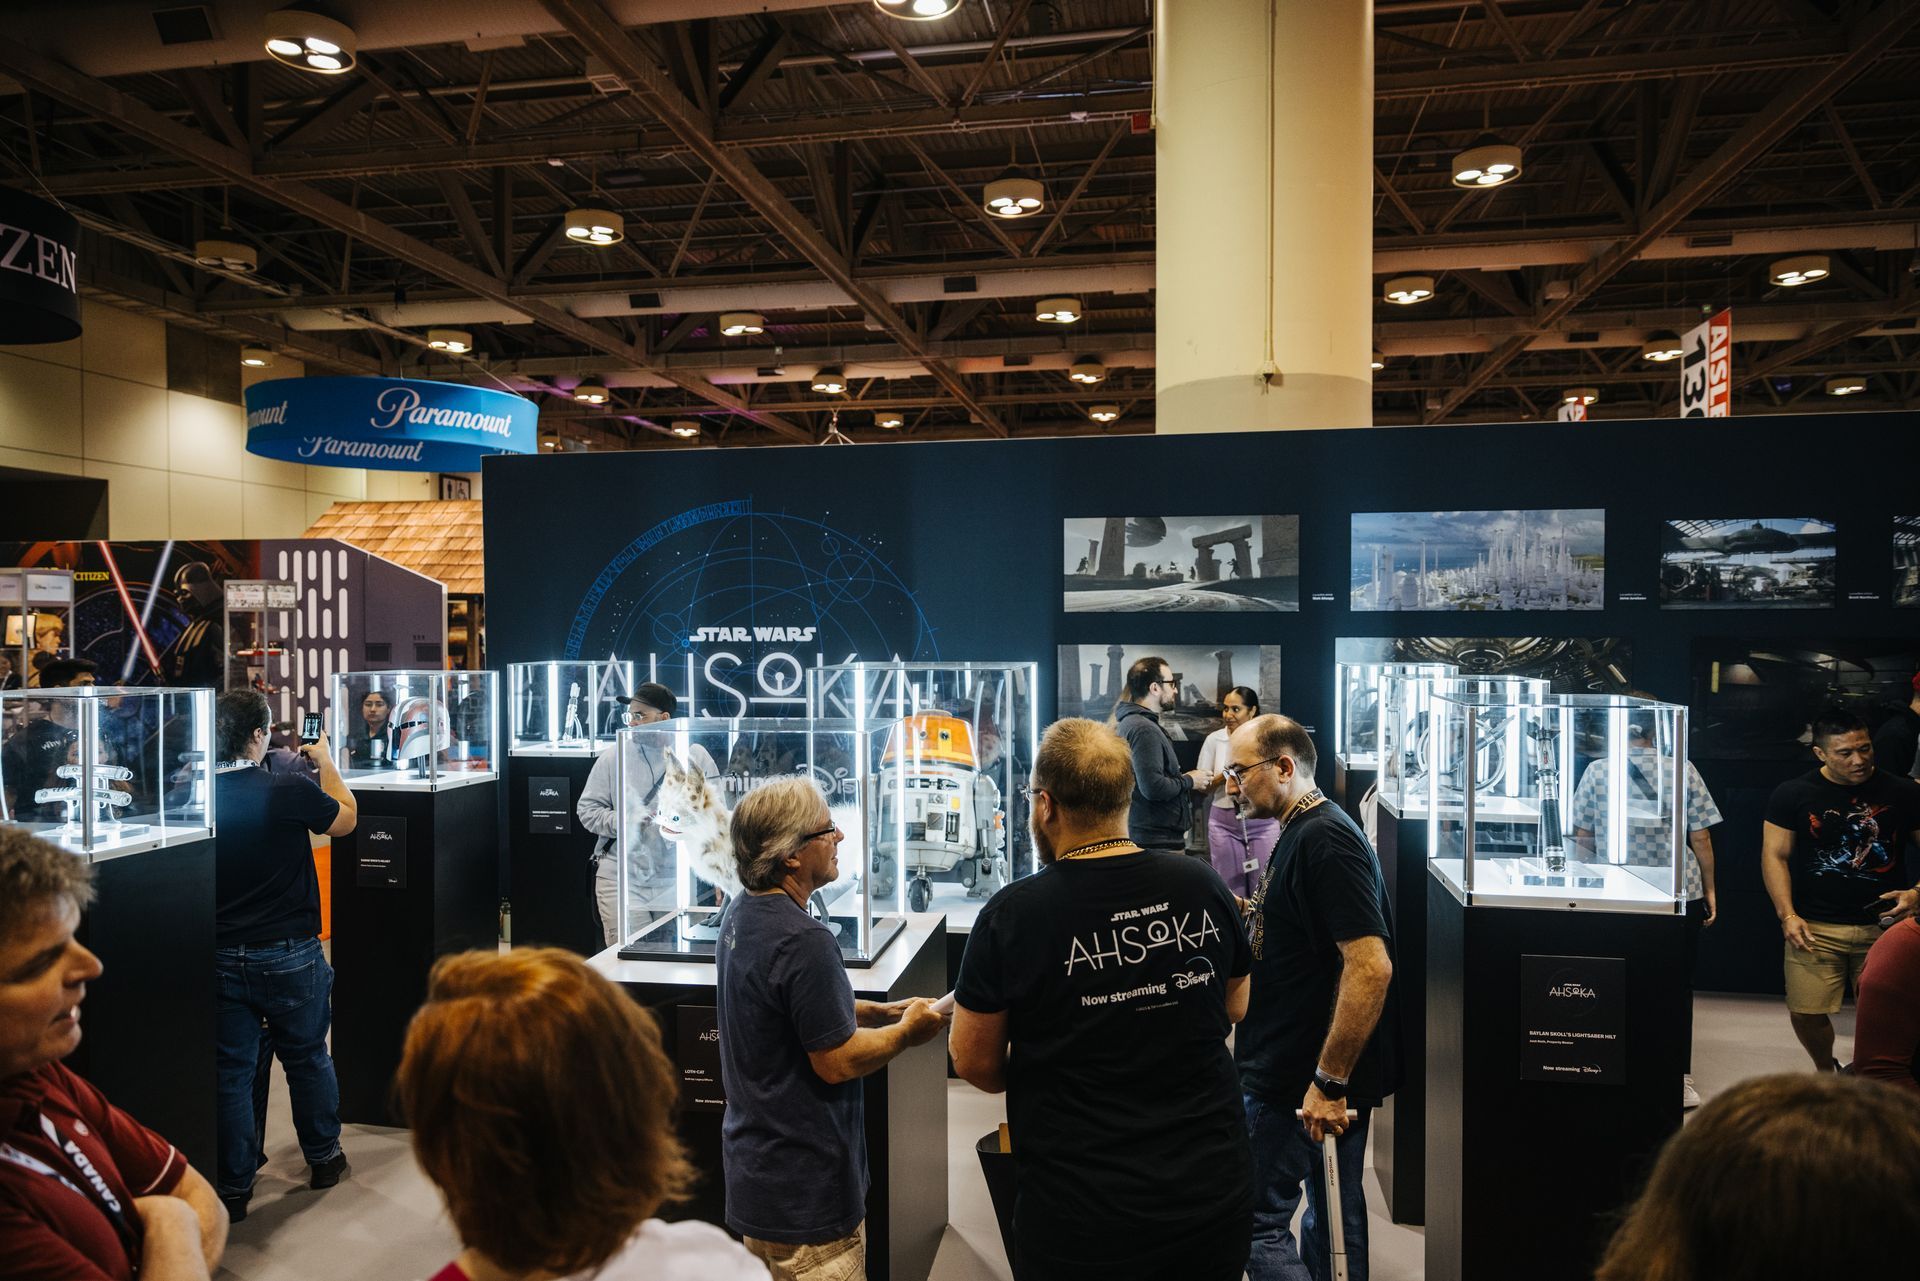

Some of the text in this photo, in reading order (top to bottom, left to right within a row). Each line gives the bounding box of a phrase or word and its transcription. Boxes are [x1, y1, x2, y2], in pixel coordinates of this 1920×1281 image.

[0, 223, 77, 294] ZEN
[371, 387, 512, 437] Paramount
[73, 571, 110, 581] CITIZEN
[689, 626, 817, 642] STAR WARS
[584, 651, 937, 720] AHSOKA
[1110, 902, 1170, 922] STAR WARS
[1064, 909, 1221, 976] AHSOKA
[1081, 994, 1108, 1007] Now
[1110, 983, 1167, 1003] streaming
[1549, 986, 1596, 999] AHSOKA
[64, 1140, 121, 1213] CANADA
